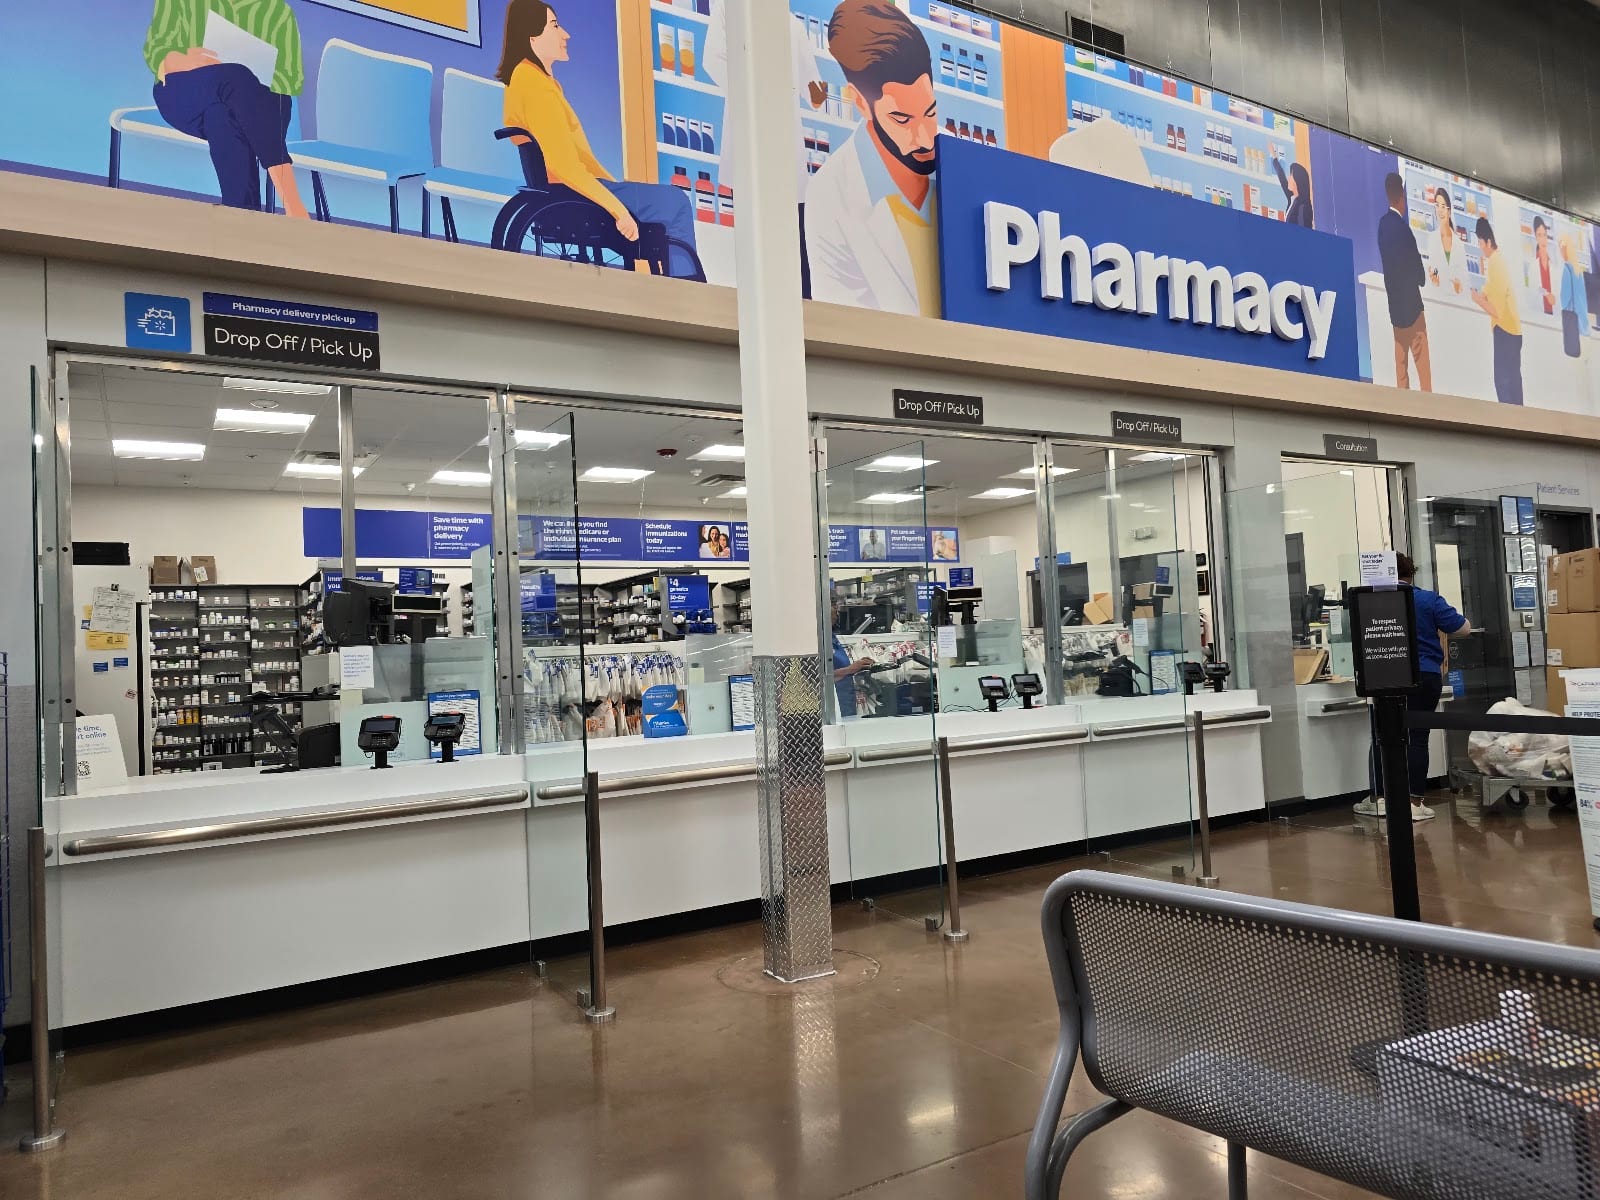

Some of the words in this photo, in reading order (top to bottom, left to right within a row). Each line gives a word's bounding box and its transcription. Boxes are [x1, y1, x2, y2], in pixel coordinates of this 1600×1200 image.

[984, 200, 1336, 360] Pharmacy
[232, 301, 281, 316] Pharmacy
[283, 308, 320, 321] delivery
[321, 312, 356, 325] pick-up
[214, 327, 261, 351] Drop
[265, 333, 300, 351] Off
[310, 337, 345, 357] Pick
[349, 342, 373, 363] Up
[898, 398, 922, 414] Drop
[924, 400, 941, 413] Off
[947, 402, 965, 415] Pick
[966, 404, 980, 419] Up
[1116, 418, 1135, 432] Drop
[1135, 421, 1149, 432] Off
[1153, 422, 1168, 434] Pick
[1168, 424, 1179, 437] Up
[1335, 440, 1369, 453] Consultation
[433, 516, 450, 524] Save
[451, 516, 468, 524] time
[468, 517, 484, 525] with
[433, 524, 470, 534] pharmacy
[433, 532, 463, 541] delivery
[646, 538, 663, 546] today
